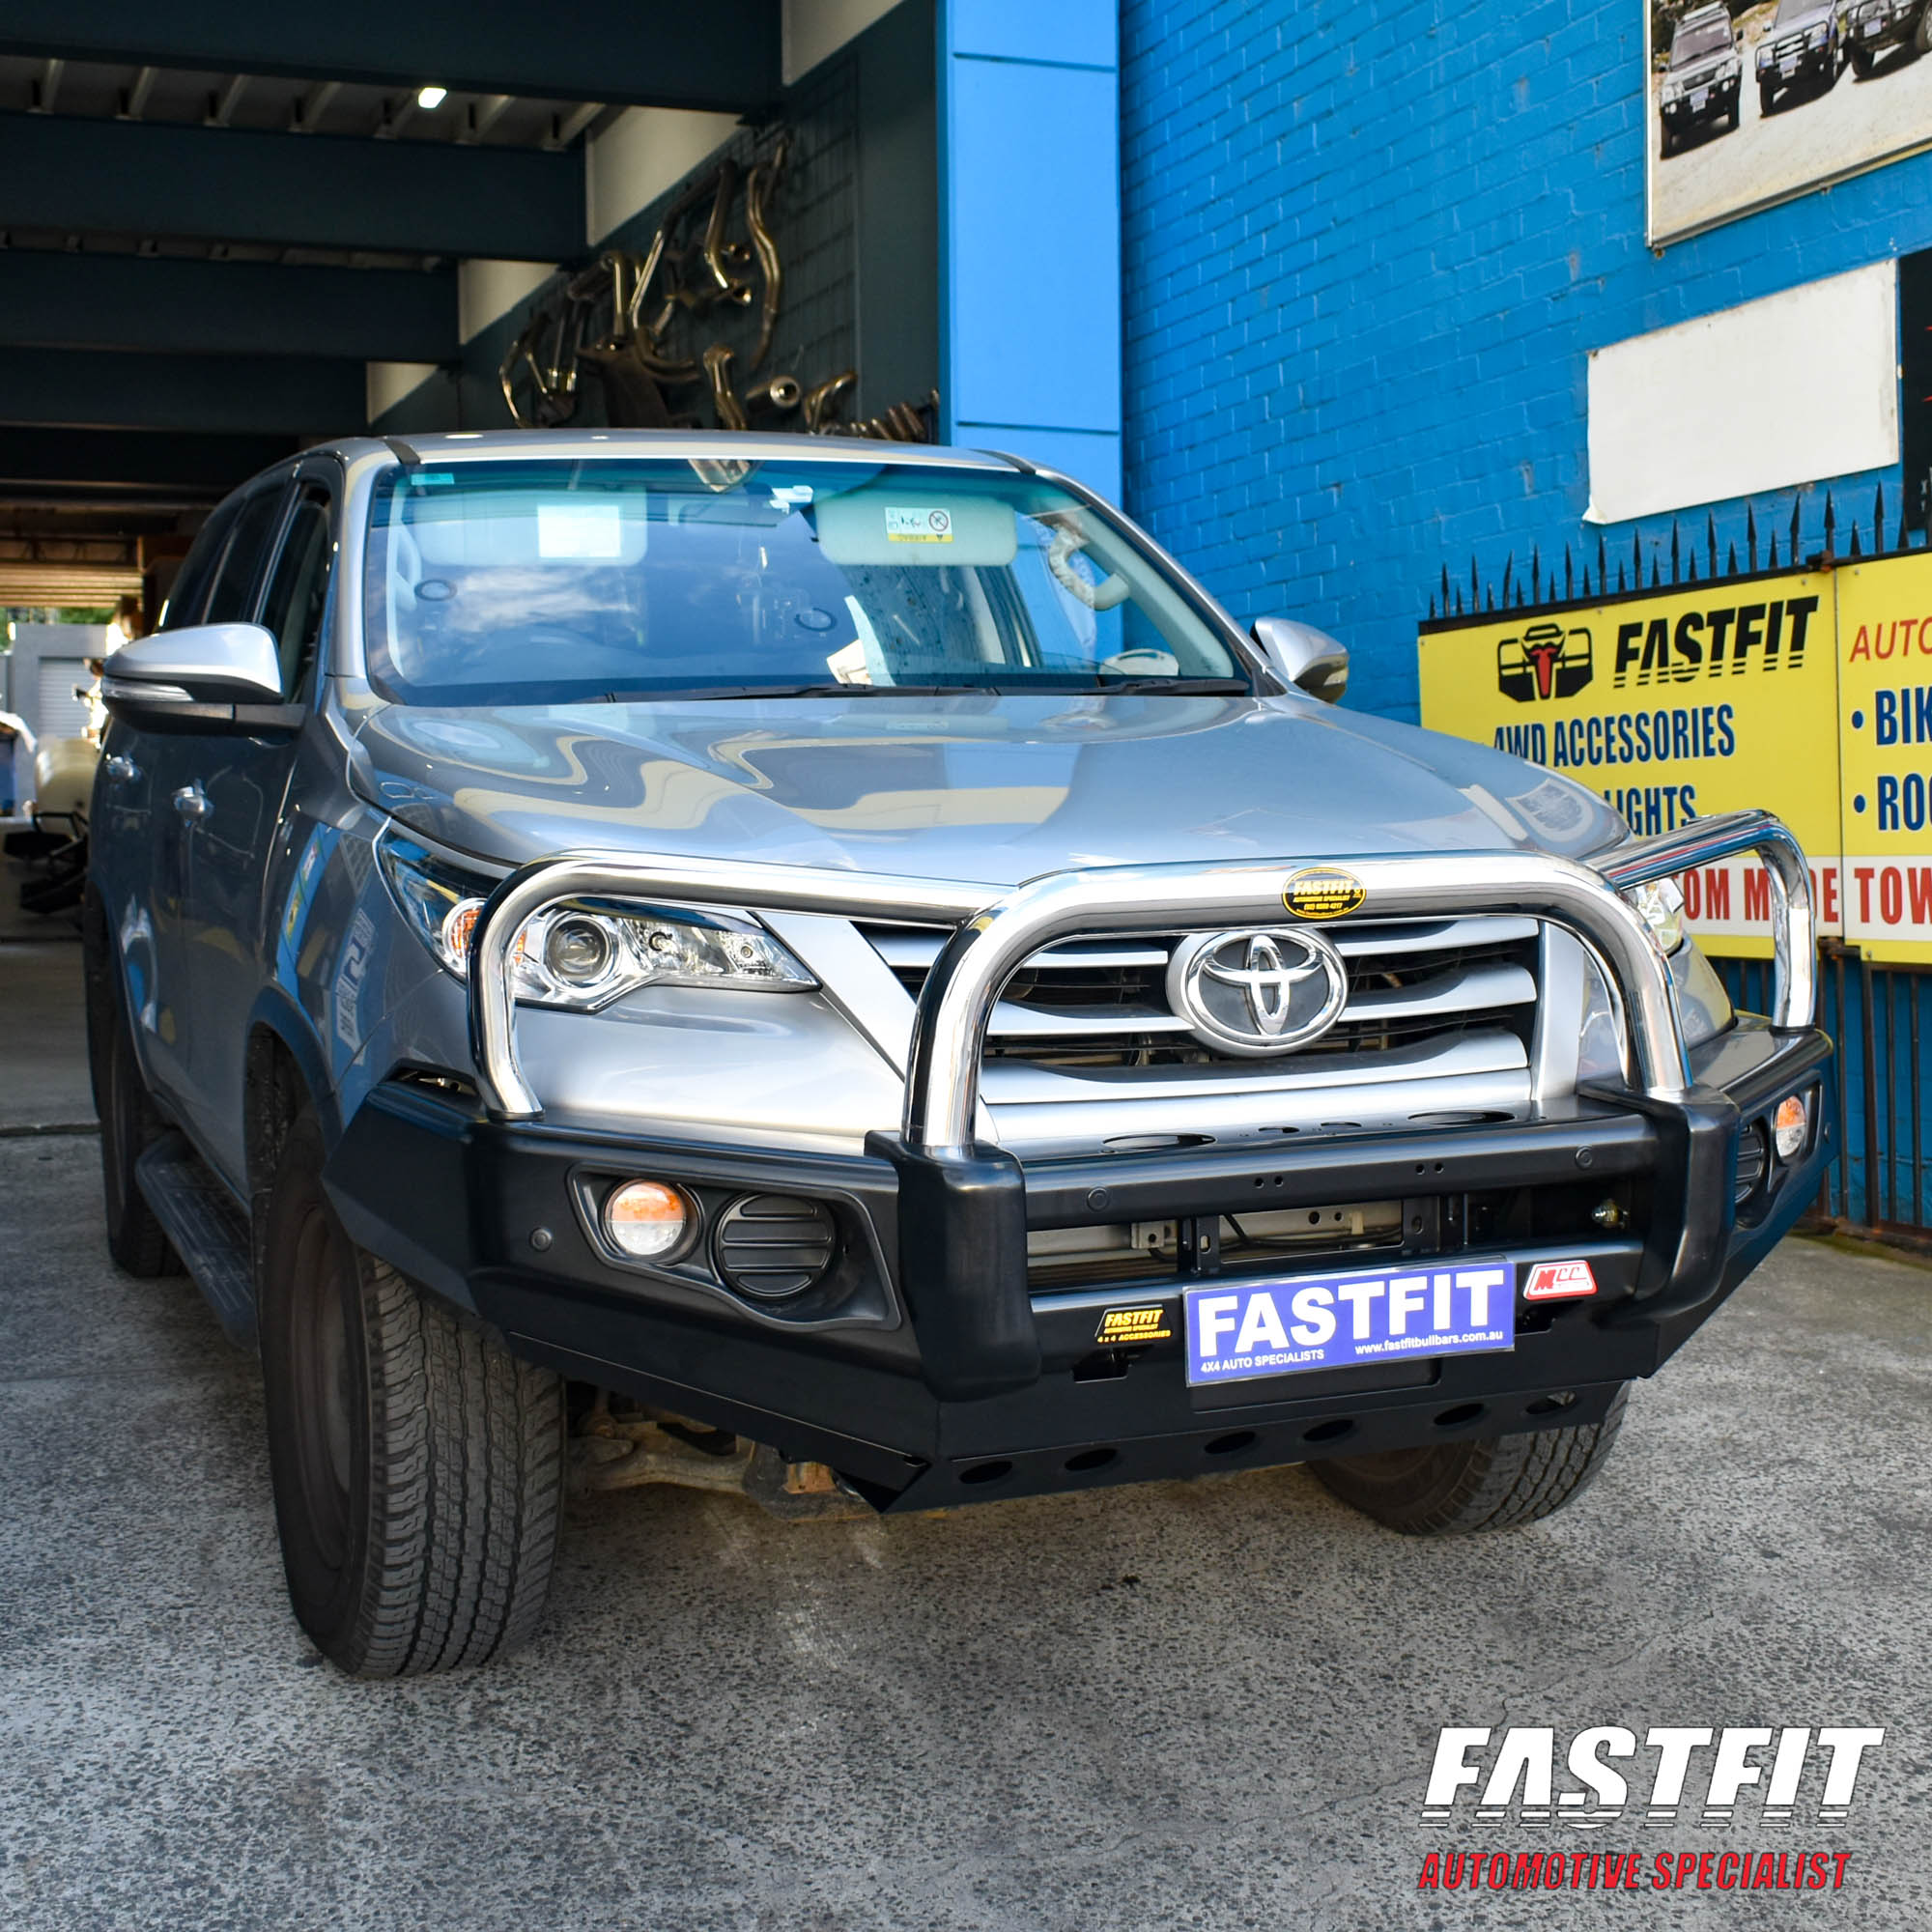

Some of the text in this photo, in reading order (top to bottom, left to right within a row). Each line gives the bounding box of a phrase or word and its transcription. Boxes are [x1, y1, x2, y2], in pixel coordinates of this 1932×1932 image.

[1613, 595, 1819, 689] FASTFIT
[1553, 704, 1735, 767] ACCESSORIES
[1604, 784, 1696, 837] IGHTS
[1877, 773, 1932, 831] RO
[1293, 879, 1355, 895] FASTFIT
[1104, 1309, 1164, 1327] FASTFIT
[1198, 1269, 1504, 1357] FASTFIT
[1201, 1349, 1324, 1373] 4X4 AUTO SPECIALISTS
[1355, 1330, 1503, 1354] www.fastfitbullbars.com.au
